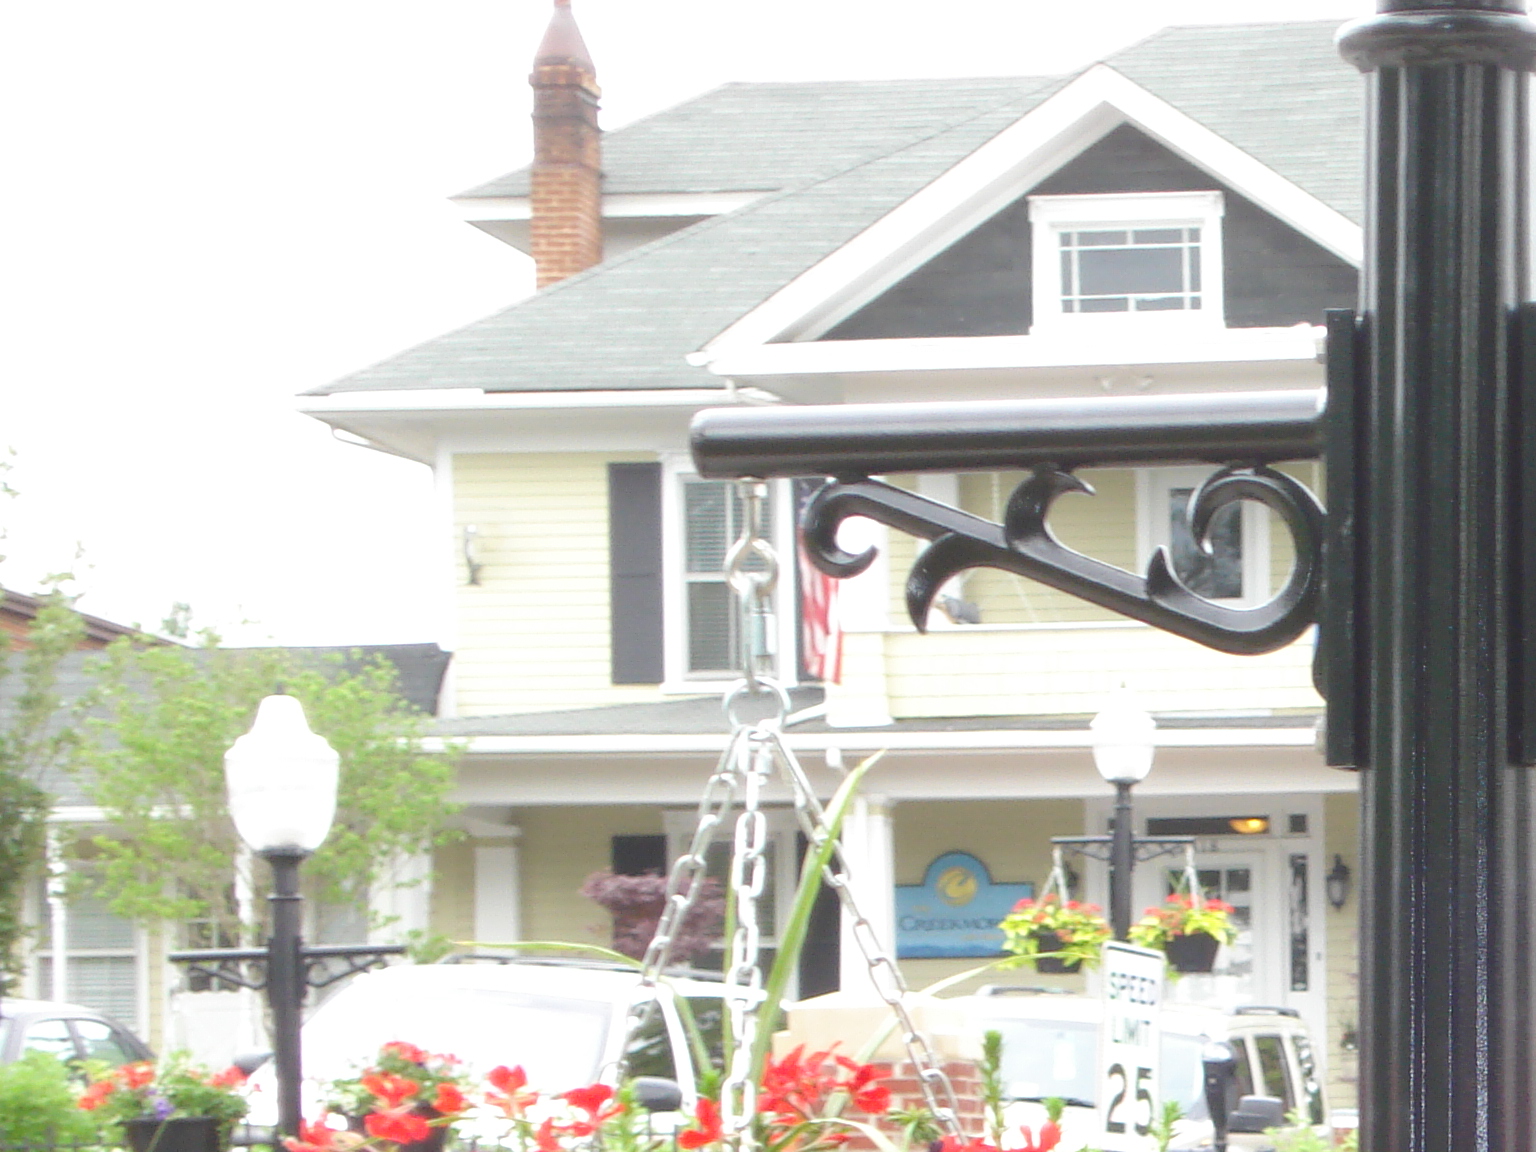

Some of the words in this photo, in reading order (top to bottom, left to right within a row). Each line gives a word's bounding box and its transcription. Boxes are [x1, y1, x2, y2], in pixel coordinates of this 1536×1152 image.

[899, 916, 1003, 931] CREEKMOR
[1110, 971, 1155, 1006] SPEED
[1105, 1062, 1153, 1136] 25
